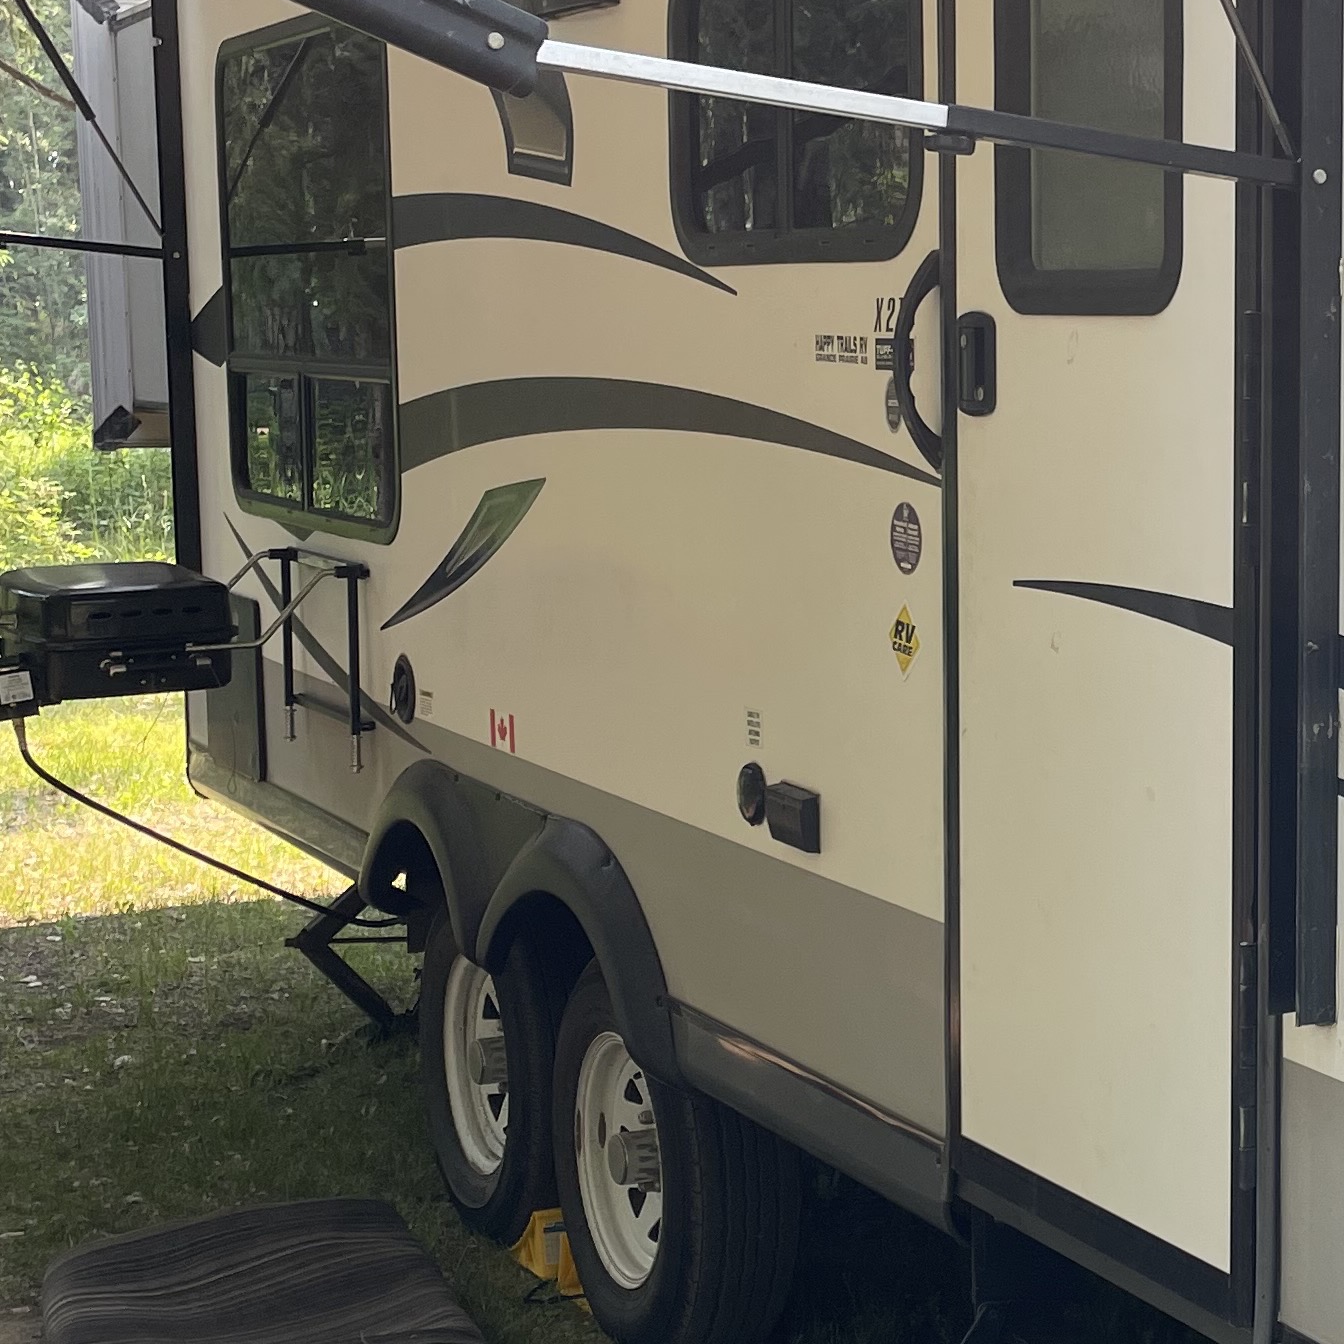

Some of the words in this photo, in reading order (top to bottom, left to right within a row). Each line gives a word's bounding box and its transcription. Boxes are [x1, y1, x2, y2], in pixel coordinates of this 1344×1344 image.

[815, 334, 835, 353] HAPPY
[836, 335, 858, 354] TRAILS
[893, 619, 917, 645] RV
[892, 640, 913, 657] CARE
